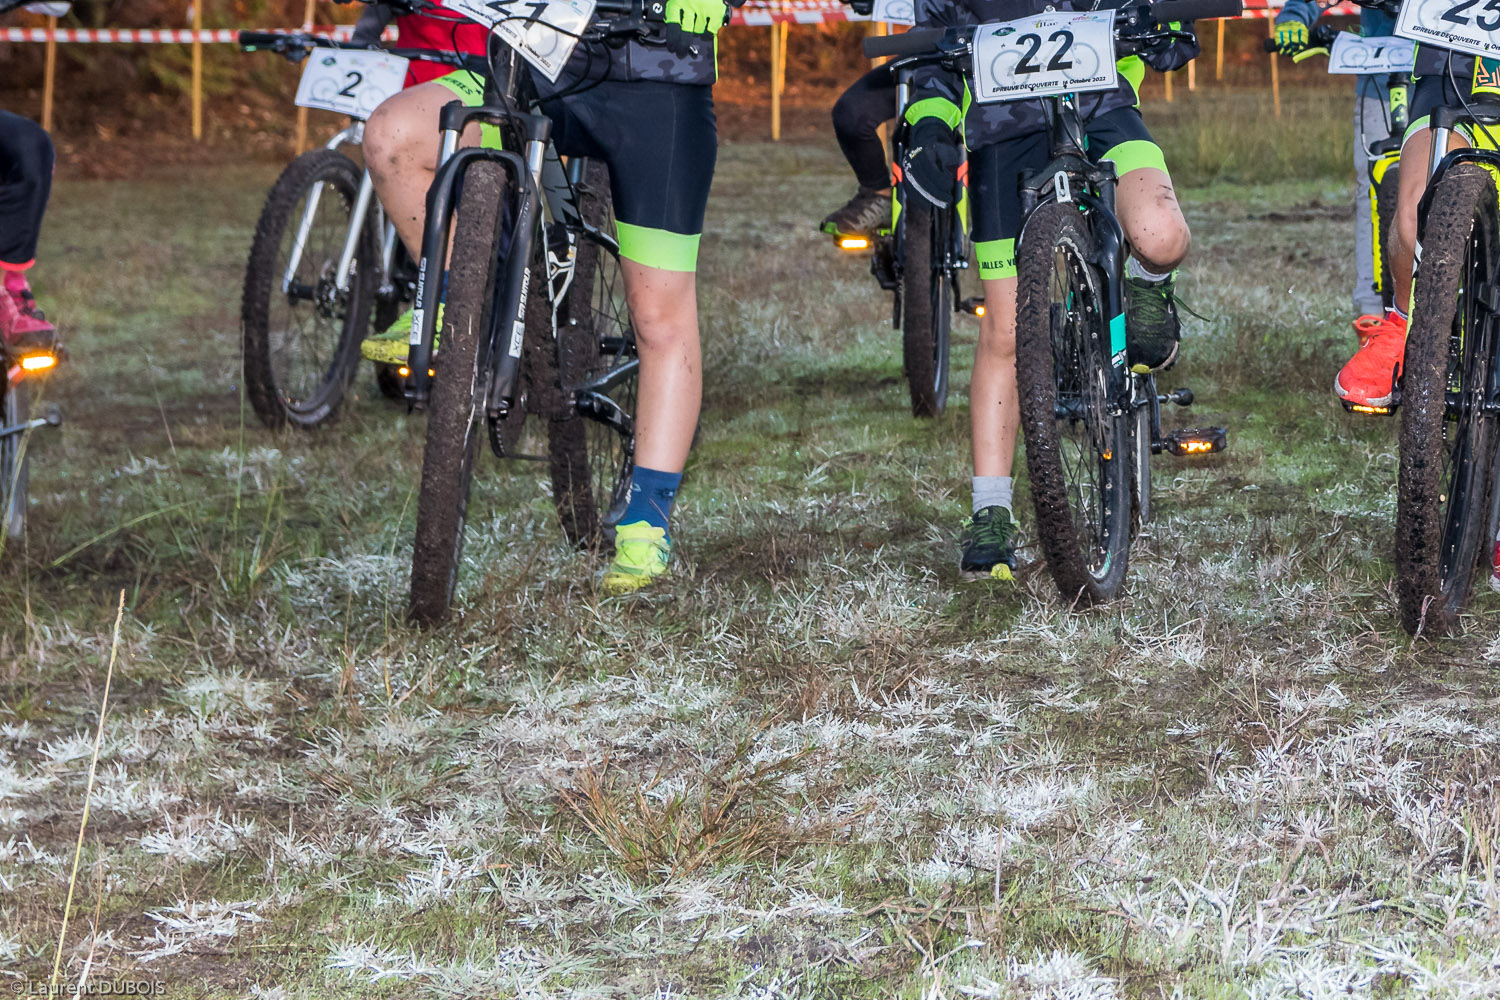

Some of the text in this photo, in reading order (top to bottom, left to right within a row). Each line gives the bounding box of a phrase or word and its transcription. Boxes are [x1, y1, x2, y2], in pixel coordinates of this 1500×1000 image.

[1015, 30, 1074, 75] 22
[338, 72, 363, 98] 2
[992, 84, 1019, 93] EPREUVE
[512, 324, 524, 354] XCE
